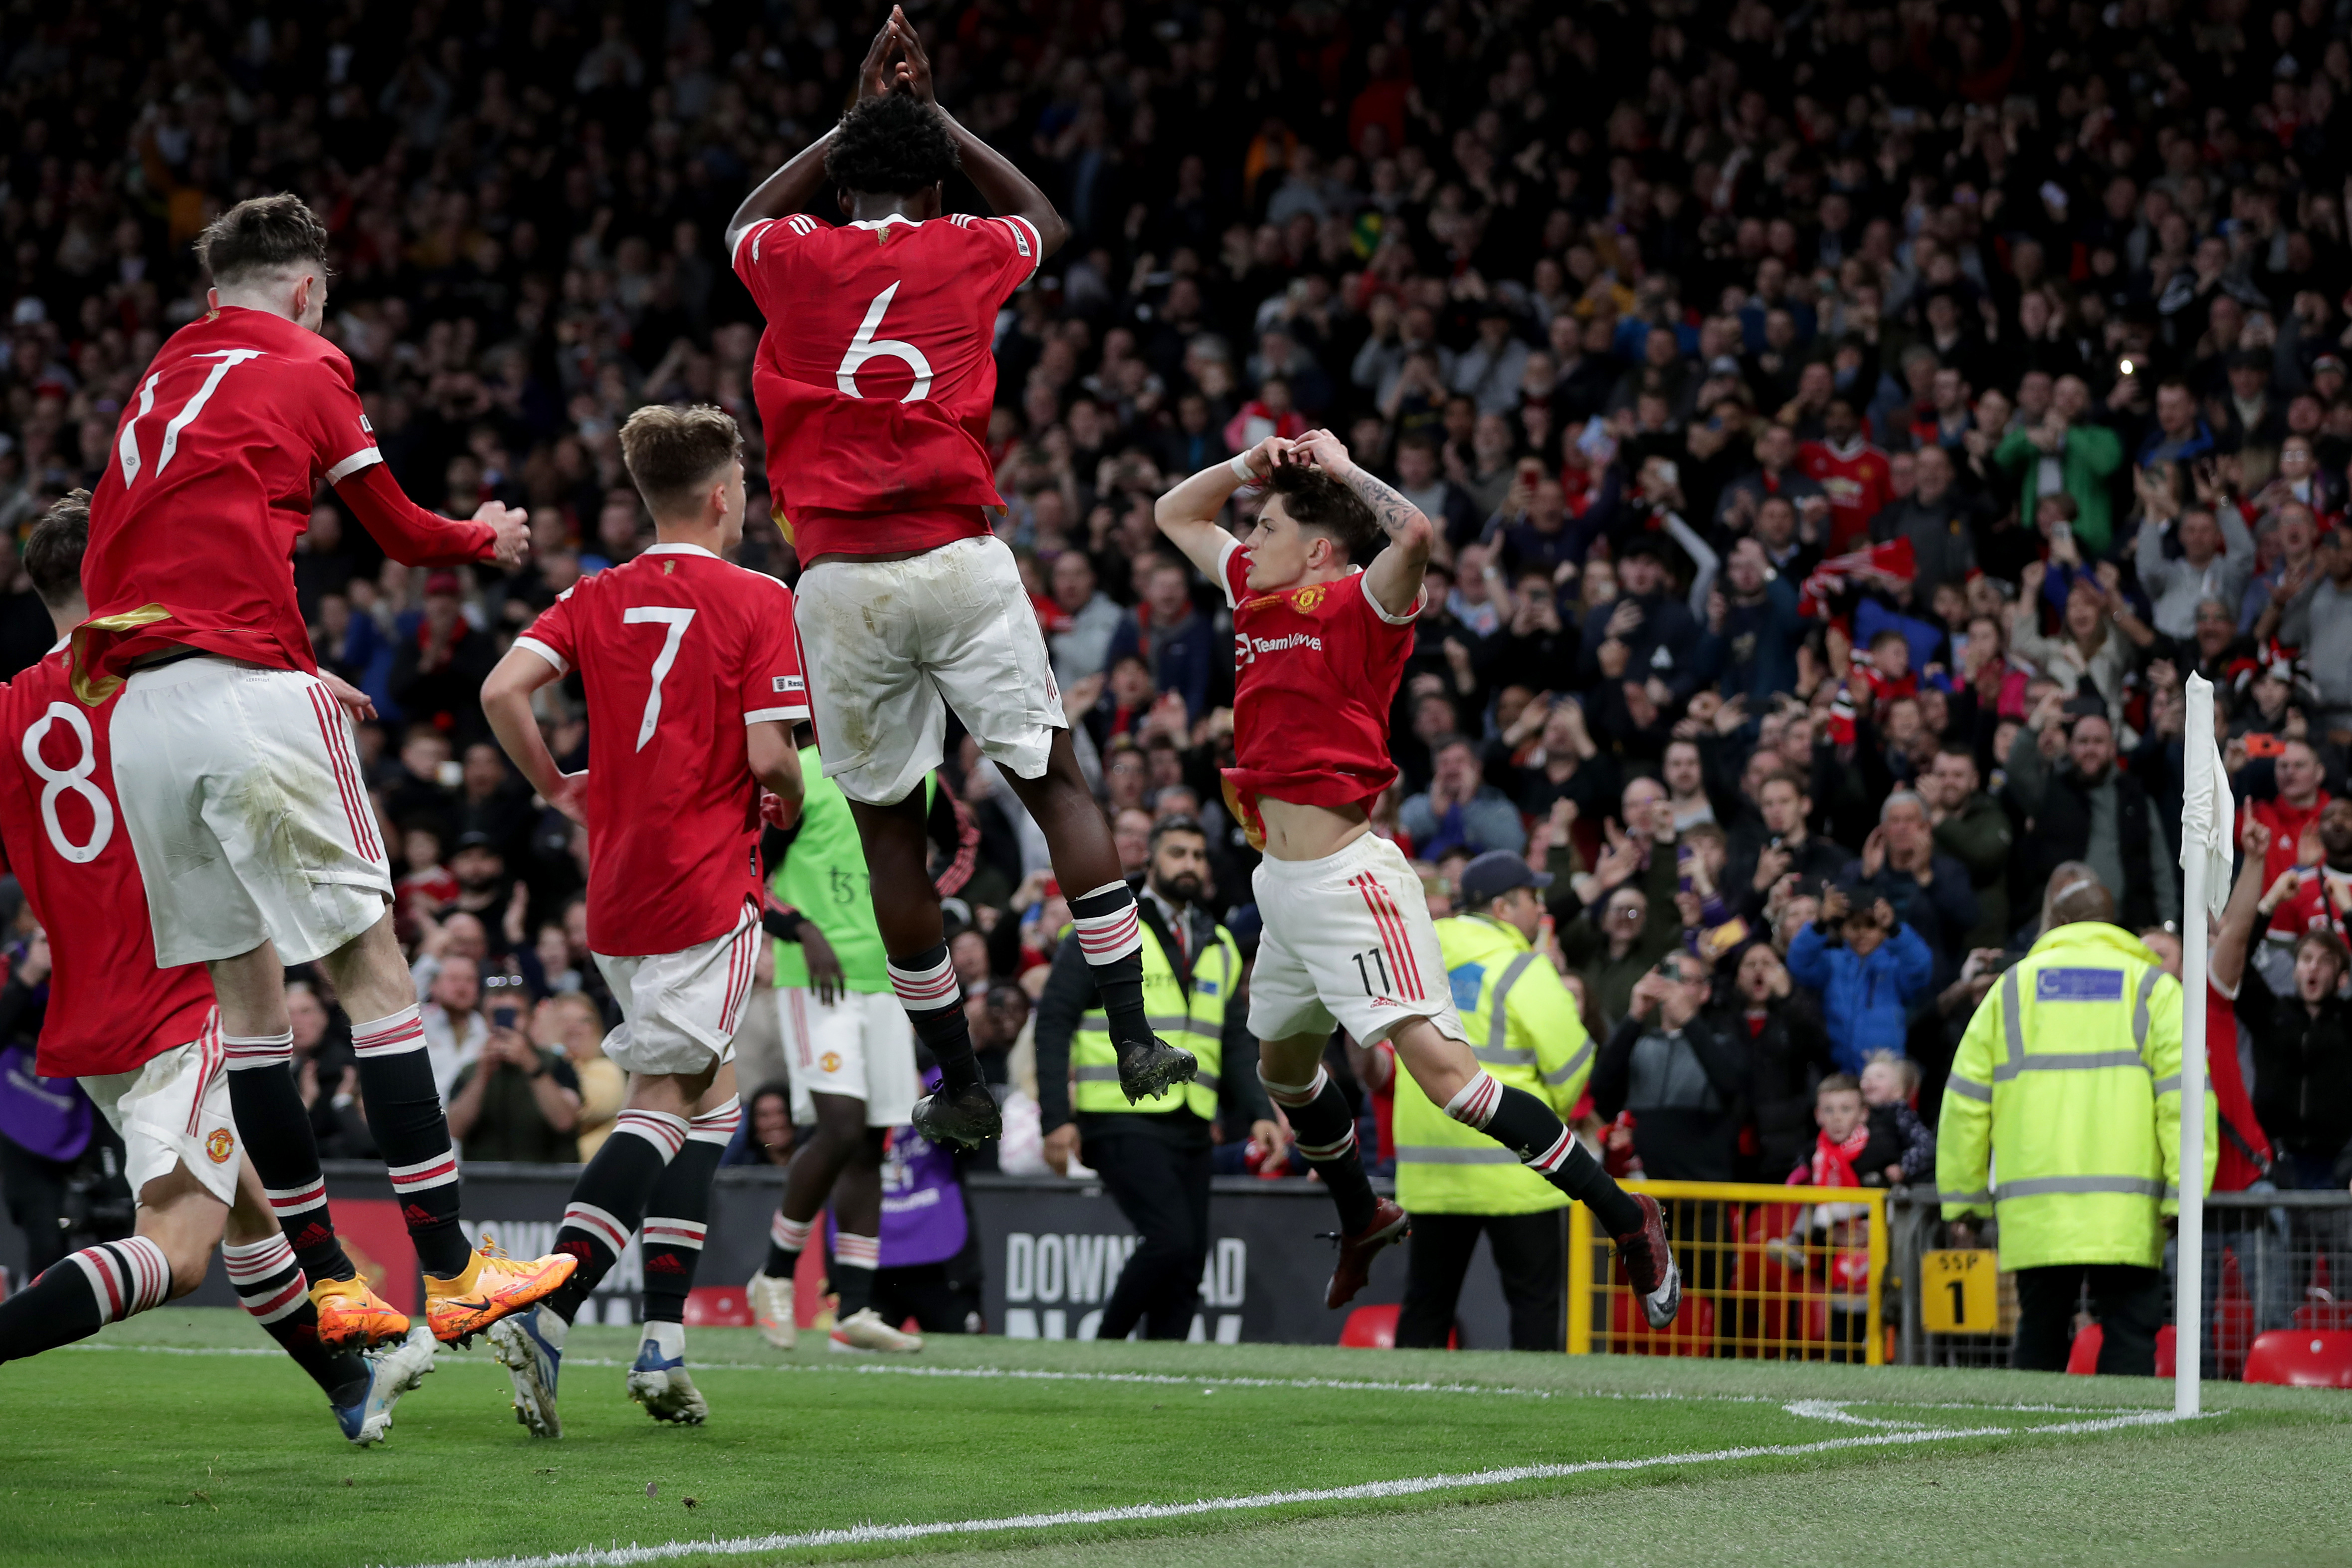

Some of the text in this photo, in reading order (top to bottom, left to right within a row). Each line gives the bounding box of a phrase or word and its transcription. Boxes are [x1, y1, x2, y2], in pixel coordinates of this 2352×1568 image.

[836, 279, 934, 404] 6
[119, 348, 268, 490] 17
[623, 606, 697, 754] 7
[21, 701, 114, 863] 8
[1352, 948, 1390, 996] 11
[1005, 1232, 1247, 1308] DOWNAD
[1946, 1279, 1963, 1324] 1
